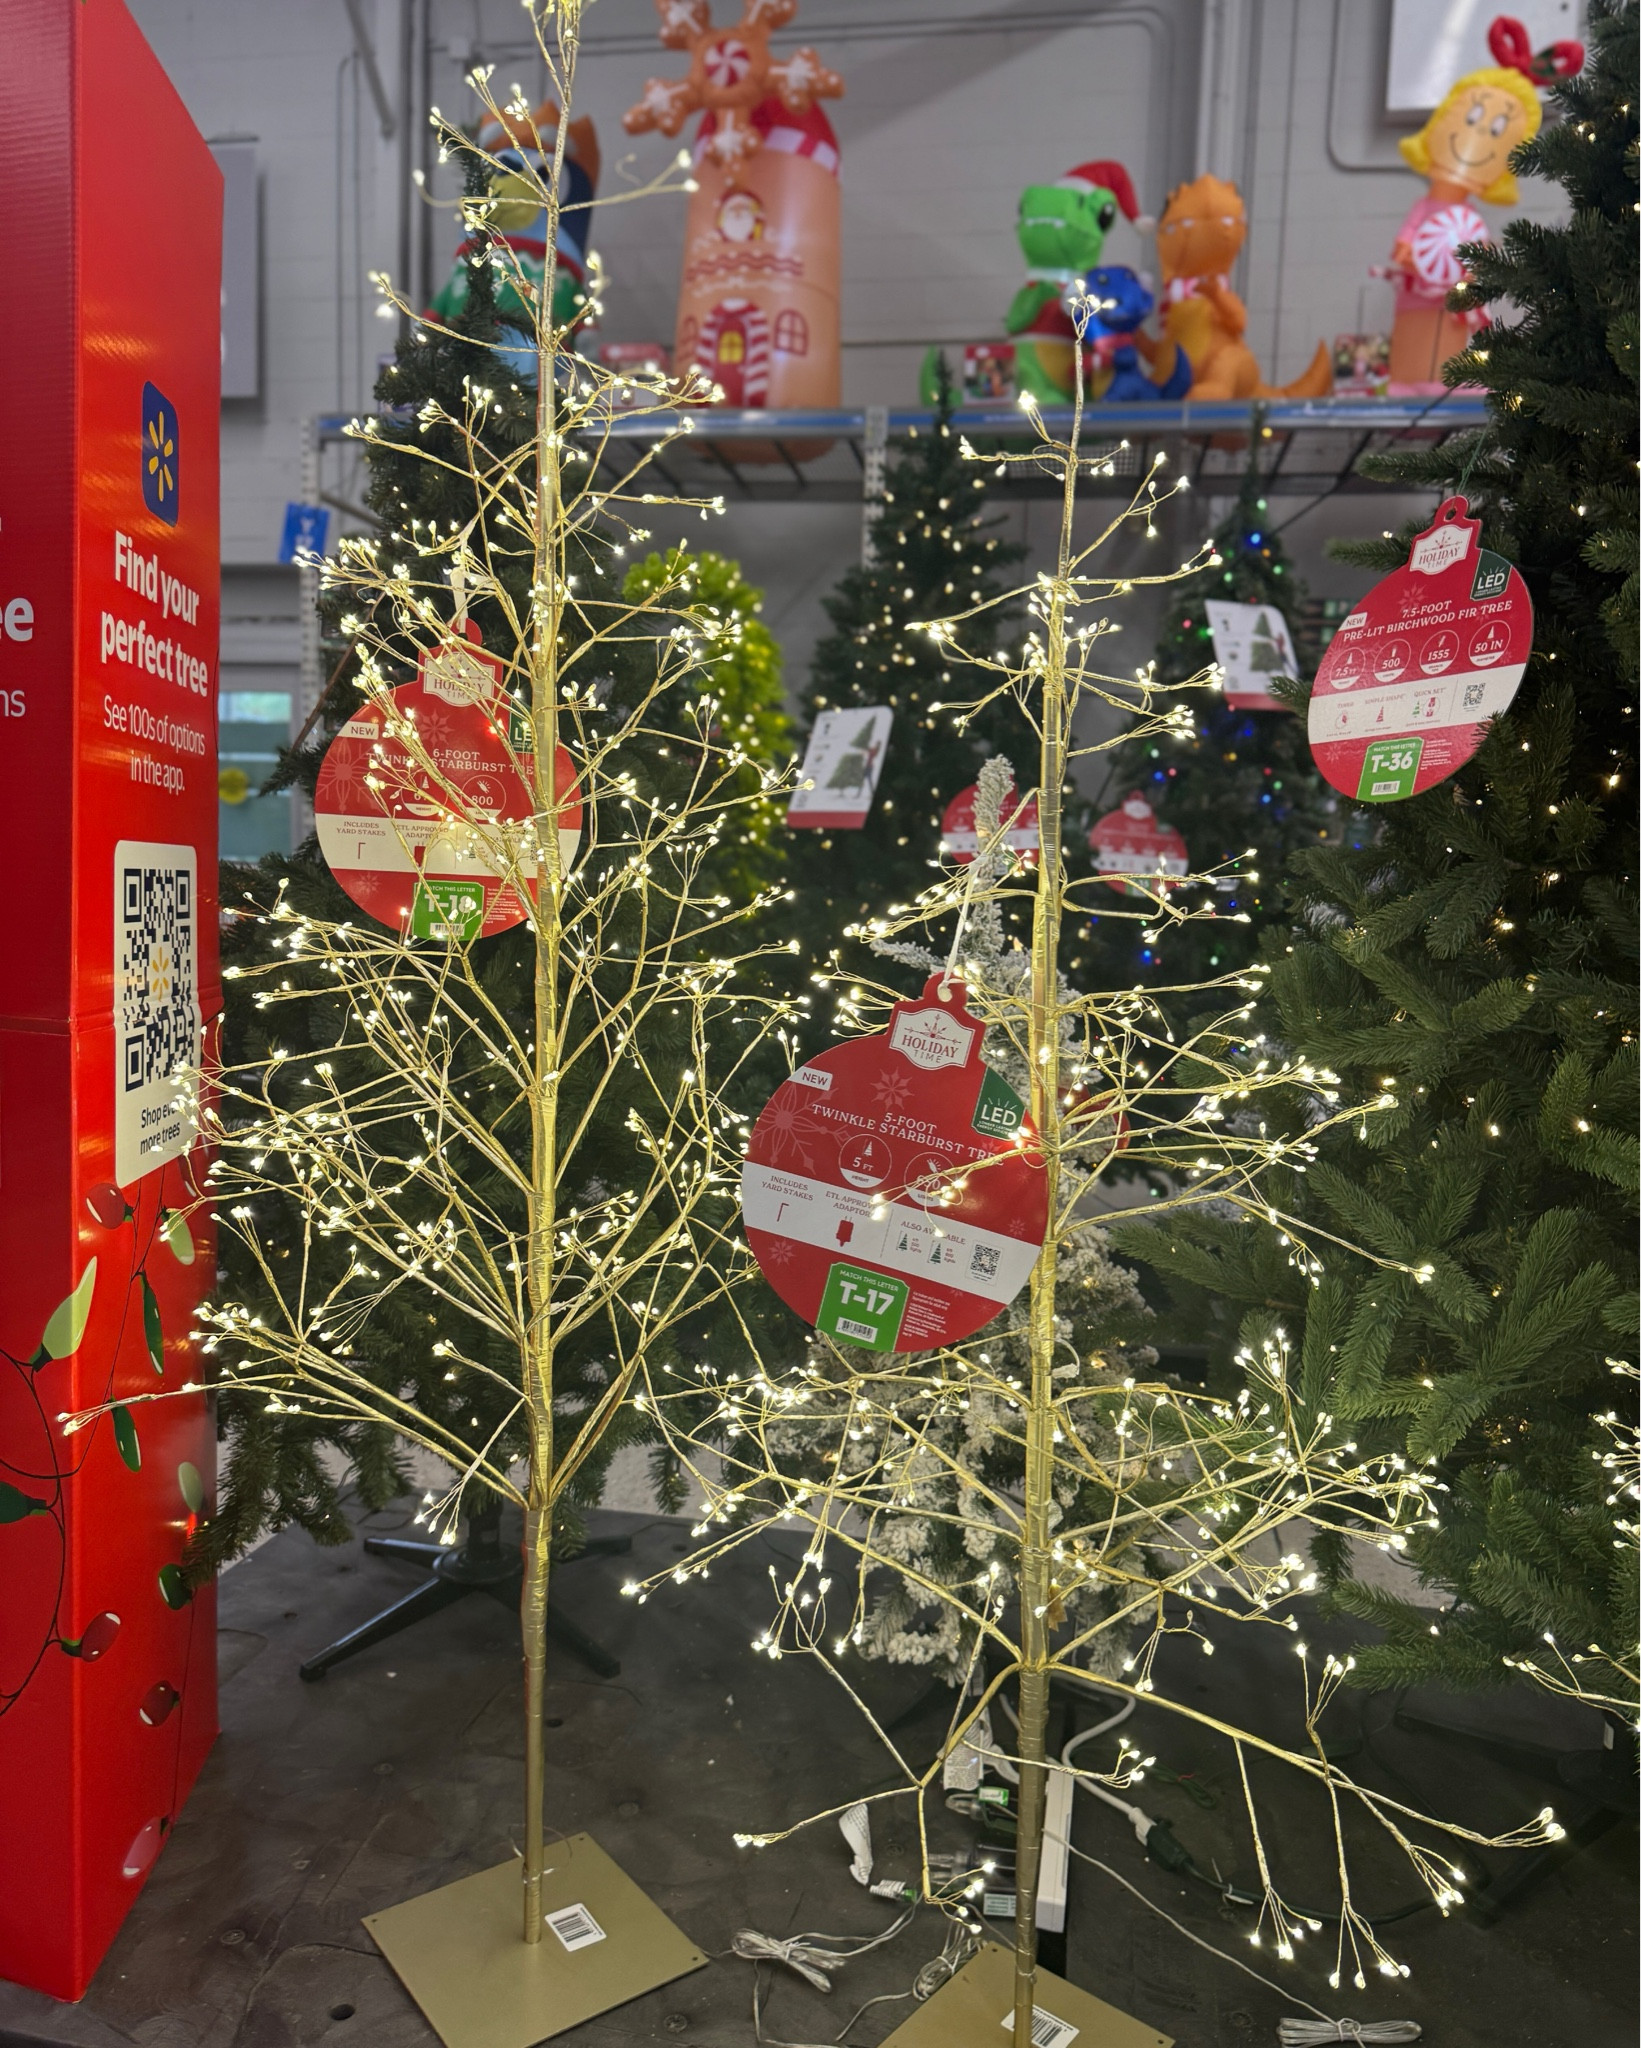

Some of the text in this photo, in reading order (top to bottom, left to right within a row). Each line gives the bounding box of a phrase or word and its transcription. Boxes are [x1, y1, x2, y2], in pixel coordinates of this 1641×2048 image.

[1418, 547, 1459, 565] HOLIDAY
[1427, 560, 1448, 569] TIME
[115, 530, 200, 626] Find your
[1477, 572, 1505, 590] LED
[1402, 600, 1452, 619] 7.5-FOOT
[1343, 600, 1513, 642] PRE-LIT BIRCHWOOD FIR TREE
[1346, 616, 1365, 627] NEW
[101, 610, 208, 697] perfect tree
[1427, 648, 1450, 661] 1555
[1474, 639, 1503, 654] 50 IN
[1381, 657, 1401, 670] 500
[1335, 667, 1349, 678] 7.5
[104, 694, 205, 756] See 100s of options
[351, 726, 375, 736] NEW
[515, 727, 532, 741] LE
[433, 748, 480, 761] 6-FOOT
[1371, 750, 1414, 773] T-36
[131, 749, 185, 796] in the app.
[431, 757, 507, 773] STARBURST
[343, 821, 380, 829] INCLUDES
[358, 828, 386, 837] STAKES
[901, 1034, 959, 1059] HOLIDAY
[914, 1049, 942, 1064] TIME
[802, 1072, 828, 1086] NEW
[141, 1107, 161, 1129] Shop
[884, 1112, 937, 1134] 5-FOOT
[981, 1104, 1017, 1126] LED
[811, 1103, 876, 1130] TWINKLE
[879, 1122, 964, 1154] STARBURST
[140, 1122, 181, 1155] more trees
[852, 1157, 874, 1172] 5 FT
[761, 1181, 814, 1201] YARD STAKES
[770, 1175, 809, 1191] INCLUDES
[825, 1190, 840, 1201] ETL
[833, 1202, 872, 1218] ADAPTOR
[900, 1221, 921, 1231] ALSO
[840, 1269, 899, 1292] MATCH THIS LETTER
[839, 1280, 895, 1315] T-17
